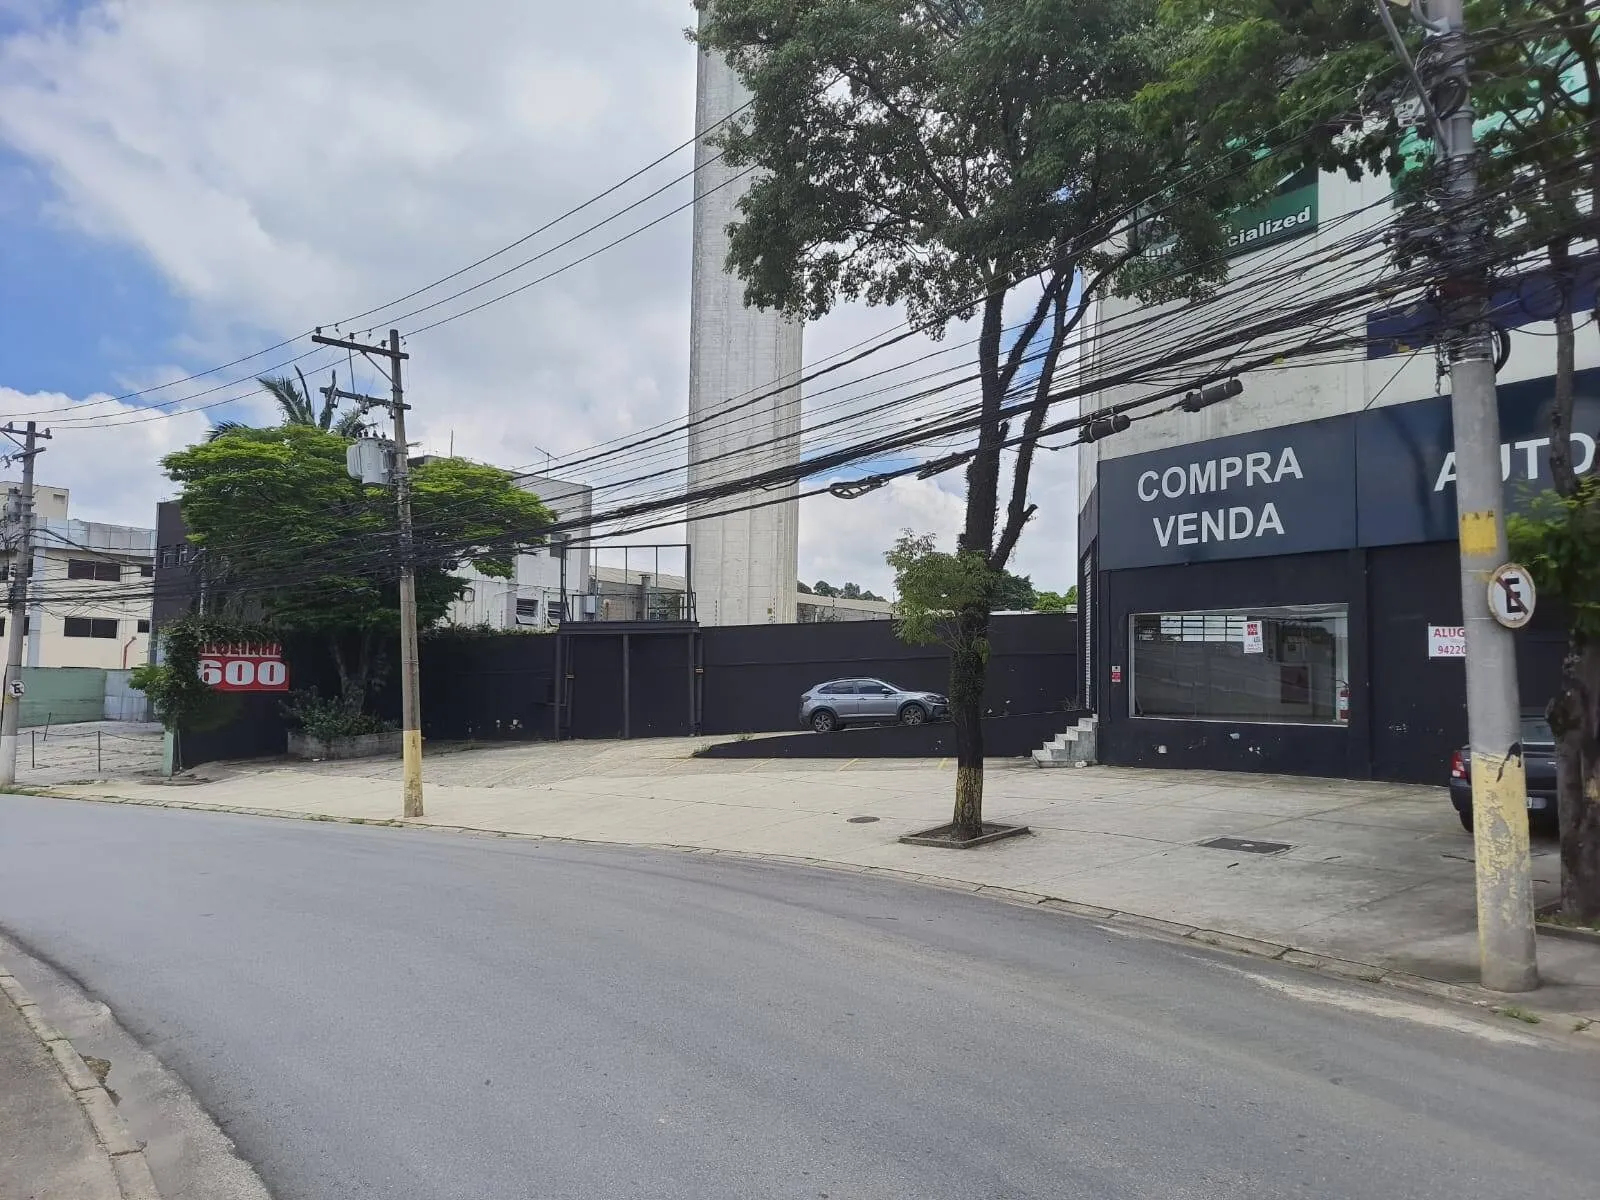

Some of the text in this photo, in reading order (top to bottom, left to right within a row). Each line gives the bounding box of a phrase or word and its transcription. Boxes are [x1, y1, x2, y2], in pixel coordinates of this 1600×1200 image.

[1137, 447, 1304, 502] COMPRA
[1152, 502, 1285, 548] VENDA
[197, 660, 286, 686] 600
